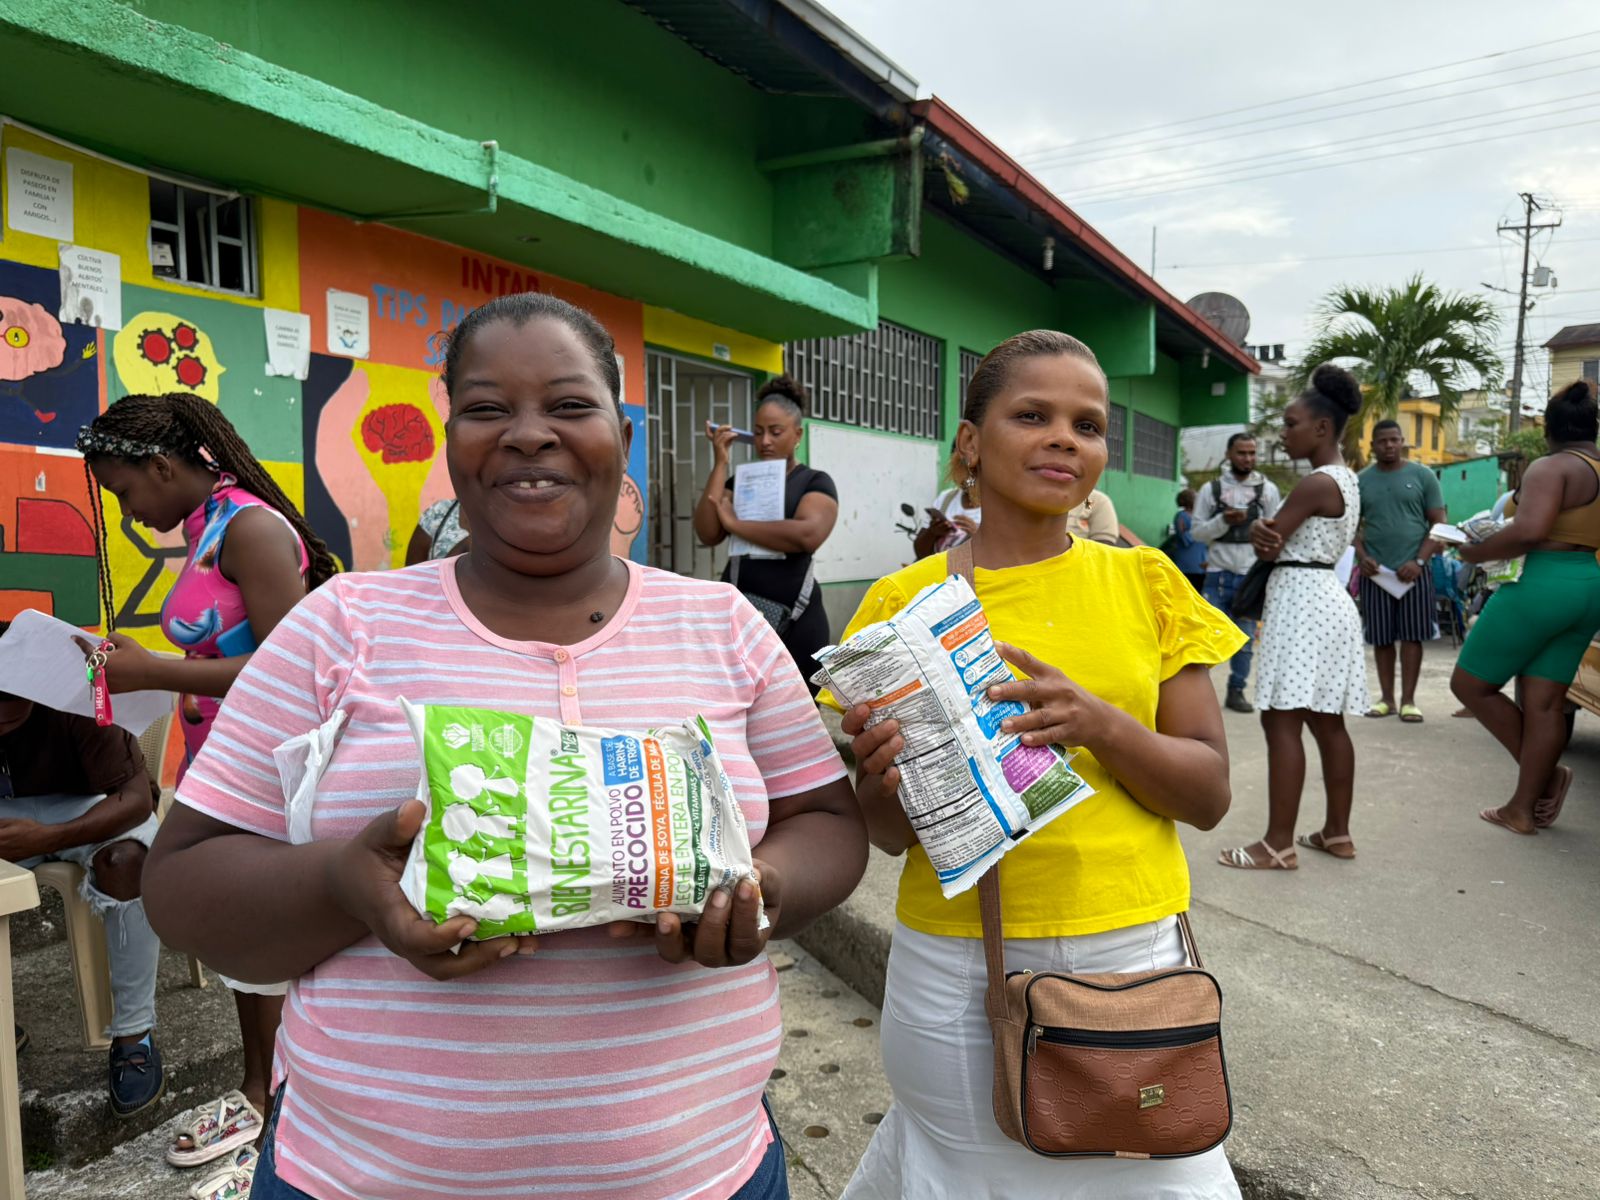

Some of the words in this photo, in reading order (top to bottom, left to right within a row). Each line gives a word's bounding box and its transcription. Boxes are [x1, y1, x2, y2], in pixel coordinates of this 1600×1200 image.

[95, 686, 104, 710] HELLO
[607, 754, 615, 771] BASE
[615, 741, 626, 776] HARINA
[626, 737, 637, 764] TRIGO
[651, 759, 660, 770] DE
[629, 766, 639, 779] DE
[672, 780, 684, 798] EN
[609, 789, 622, 825] POLVO
[651, 772, 664, 810] FÉCULA
[690, 777, 701, 821] VITAMINAS
[612, 828, 624, 846] EN
[624, 785, 647, 909] PRECOCIDO
[656, 814, 667, 847] SOYA,
[672, 803, 689, 859] ENTERA
[657, 850, 669, 864] DE
[613, 849, 625, 906] ALIMENTO
[657, 869, 670, 906] HARINA
[674, 864, 691, 906] LECHE
